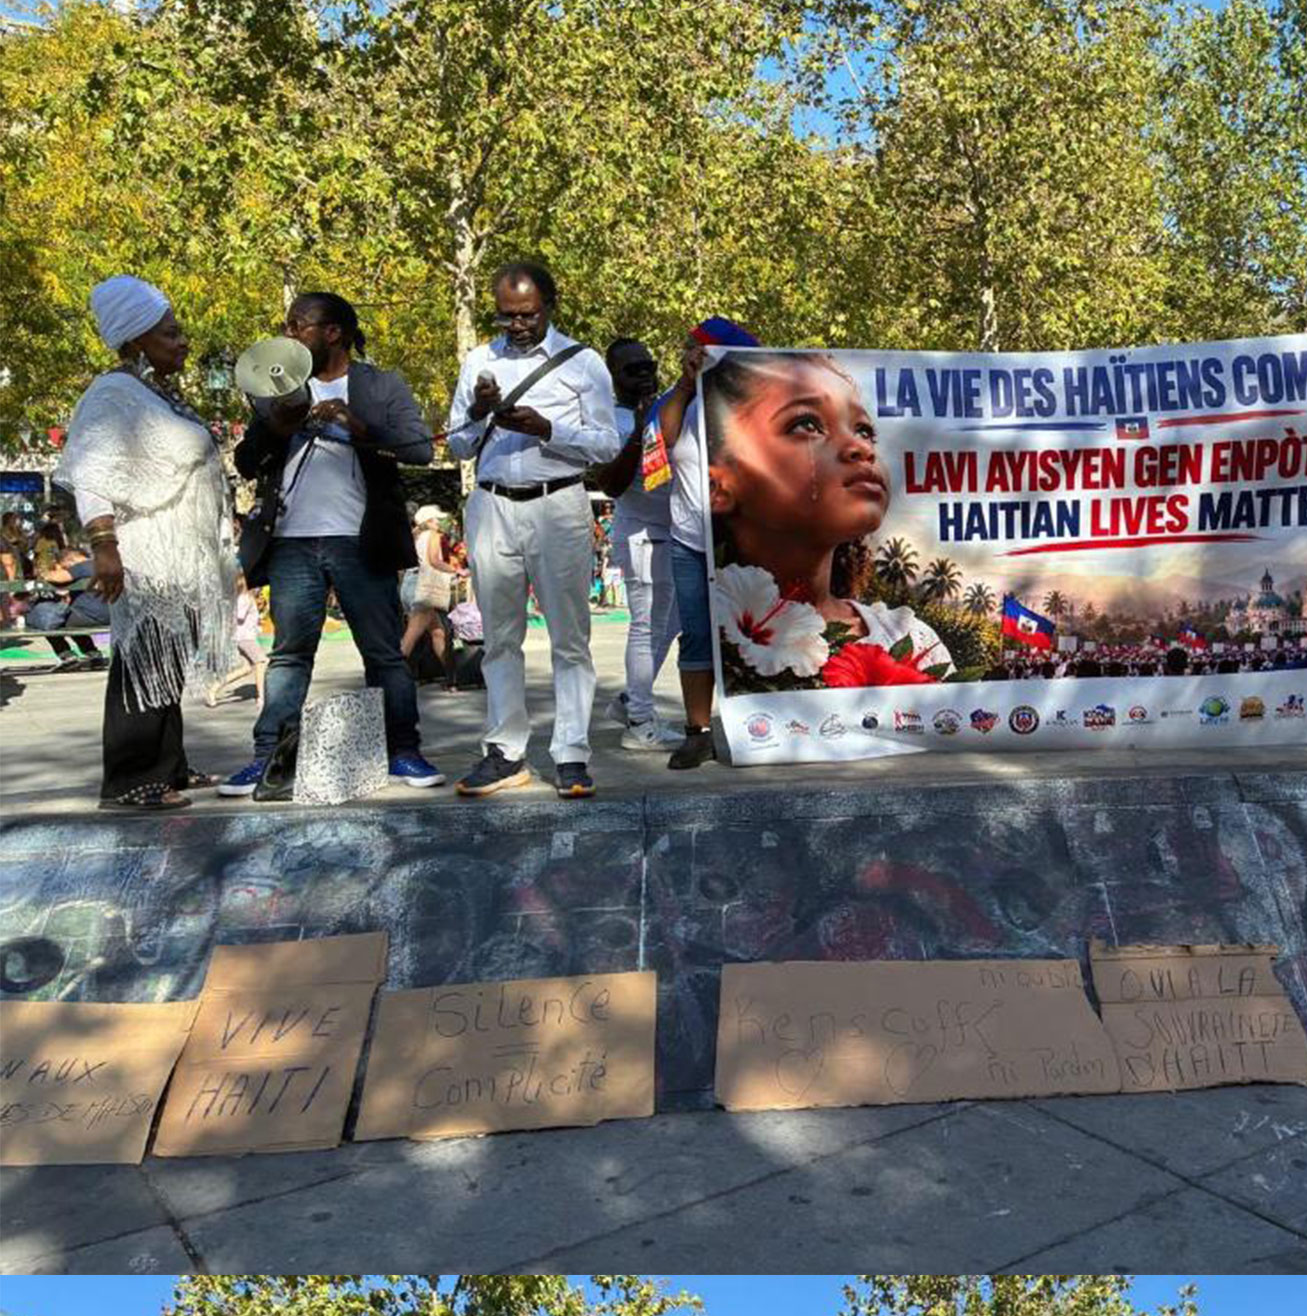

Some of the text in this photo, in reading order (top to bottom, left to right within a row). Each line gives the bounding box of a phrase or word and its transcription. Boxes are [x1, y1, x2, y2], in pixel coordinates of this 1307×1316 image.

[875, 367, 922, 418] LA
[925, 368, 983, 419] VIE
[988, 366, 1057, 419] DES
[1063, 354, 1227, 418] HAÏTIENS
[904, 450, 979, 494] LAVI
[985, 447, 1125, 494] AYISYEN
[1134, 442, 1204, 489] GEN
[938, 499, 1081, 542] HAITIAN
[1090, 493, 1190, 538] LIVES
[1217, 964, 1258, 996] LA
[219, 1006, 343, 1051] VIVE
[28, 1057, 107, 1084] AUX
[183, 1064, 332, 1125] HAITI
